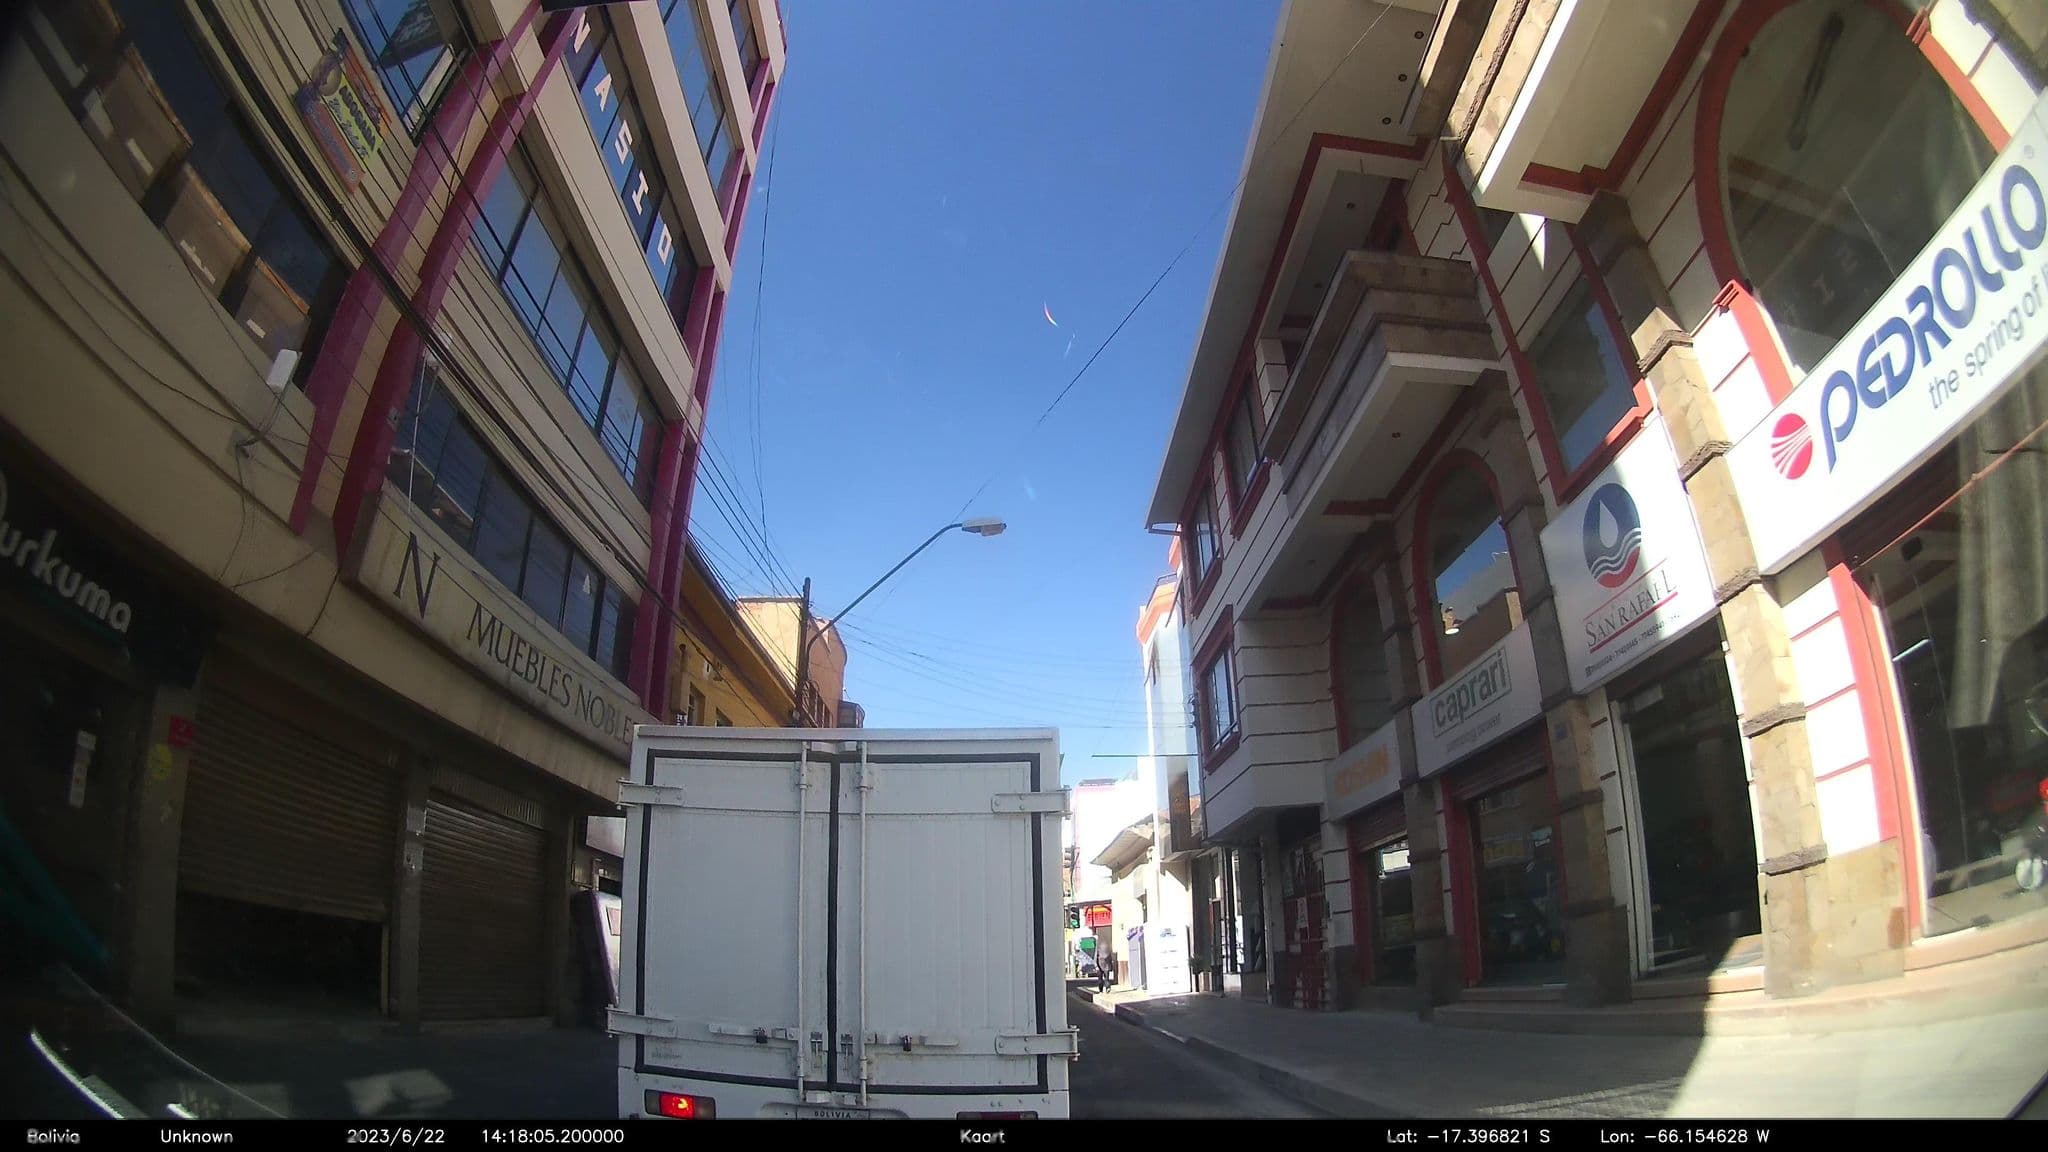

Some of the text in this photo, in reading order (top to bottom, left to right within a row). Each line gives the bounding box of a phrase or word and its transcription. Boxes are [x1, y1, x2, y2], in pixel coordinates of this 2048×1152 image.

[1819, 164, 2048, 475] PEDROLLO
[1928, 274, 2043, 410] the spring of
[466, 601, 573, 709] MUEBLES
[1584, 614, 1617, 648] SAN
[1433, 652, 1508, 730] caprari
[814, 1110, 852, 1119] BOLIVIA
